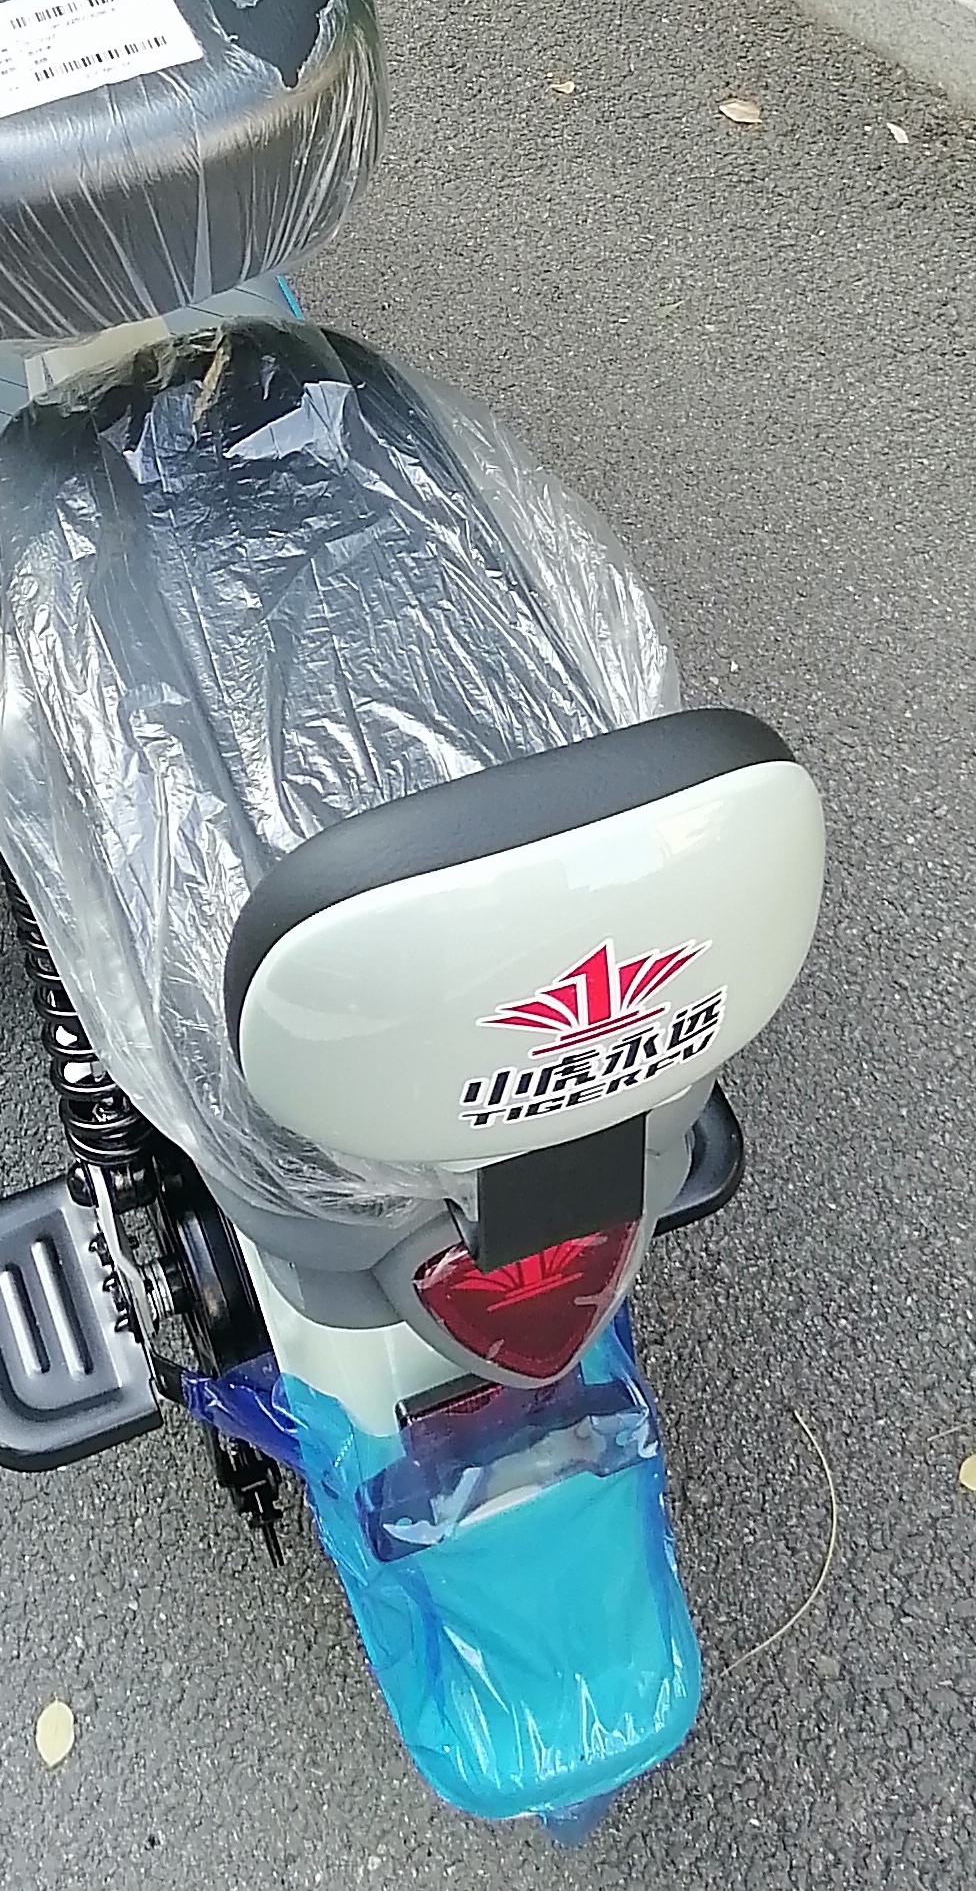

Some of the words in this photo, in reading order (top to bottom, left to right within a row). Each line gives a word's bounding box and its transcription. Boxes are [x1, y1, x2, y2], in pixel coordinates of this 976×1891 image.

[460, 1030, 714, 1127] TIGERFV
[462, 990, 724, 1106] 小虎永远
